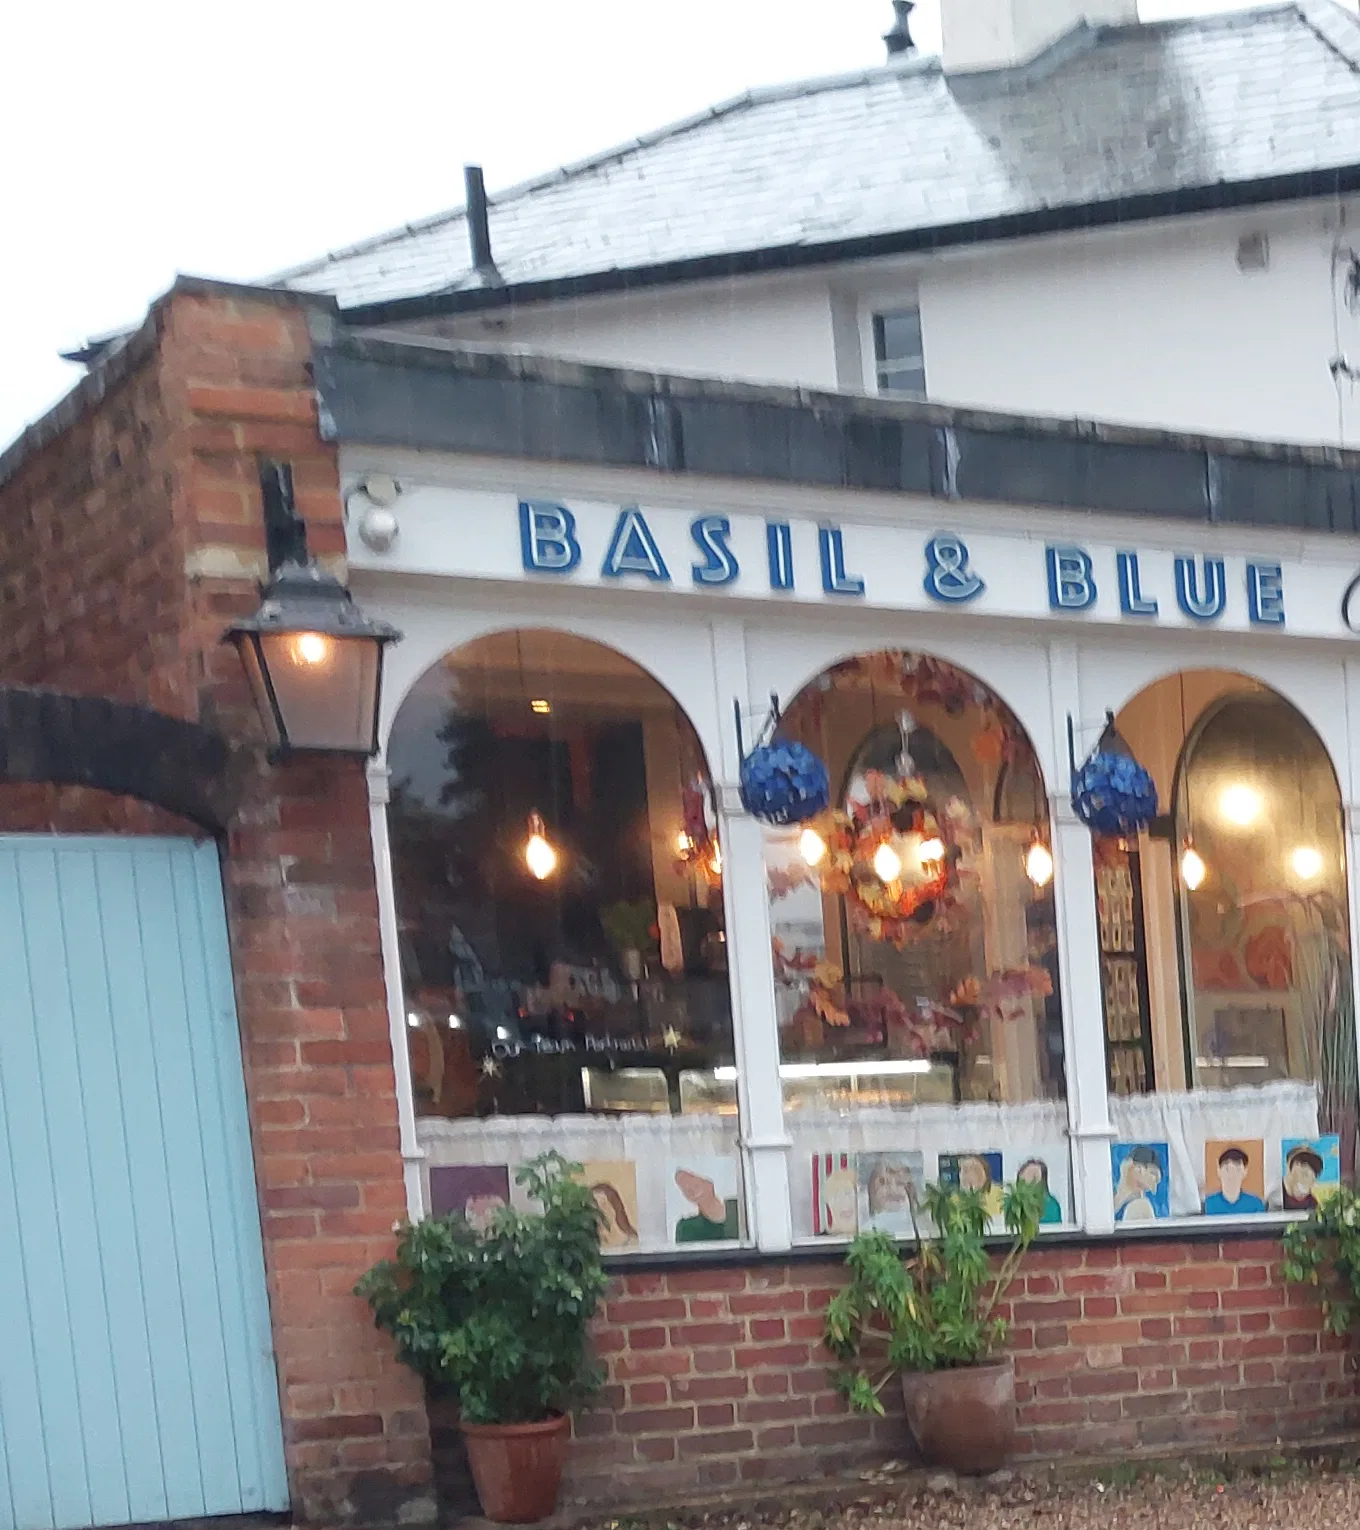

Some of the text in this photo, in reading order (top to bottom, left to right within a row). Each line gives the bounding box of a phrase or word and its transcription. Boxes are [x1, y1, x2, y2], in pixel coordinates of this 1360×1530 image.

[517, 498, 1286, 627] BASIL & BLUE
